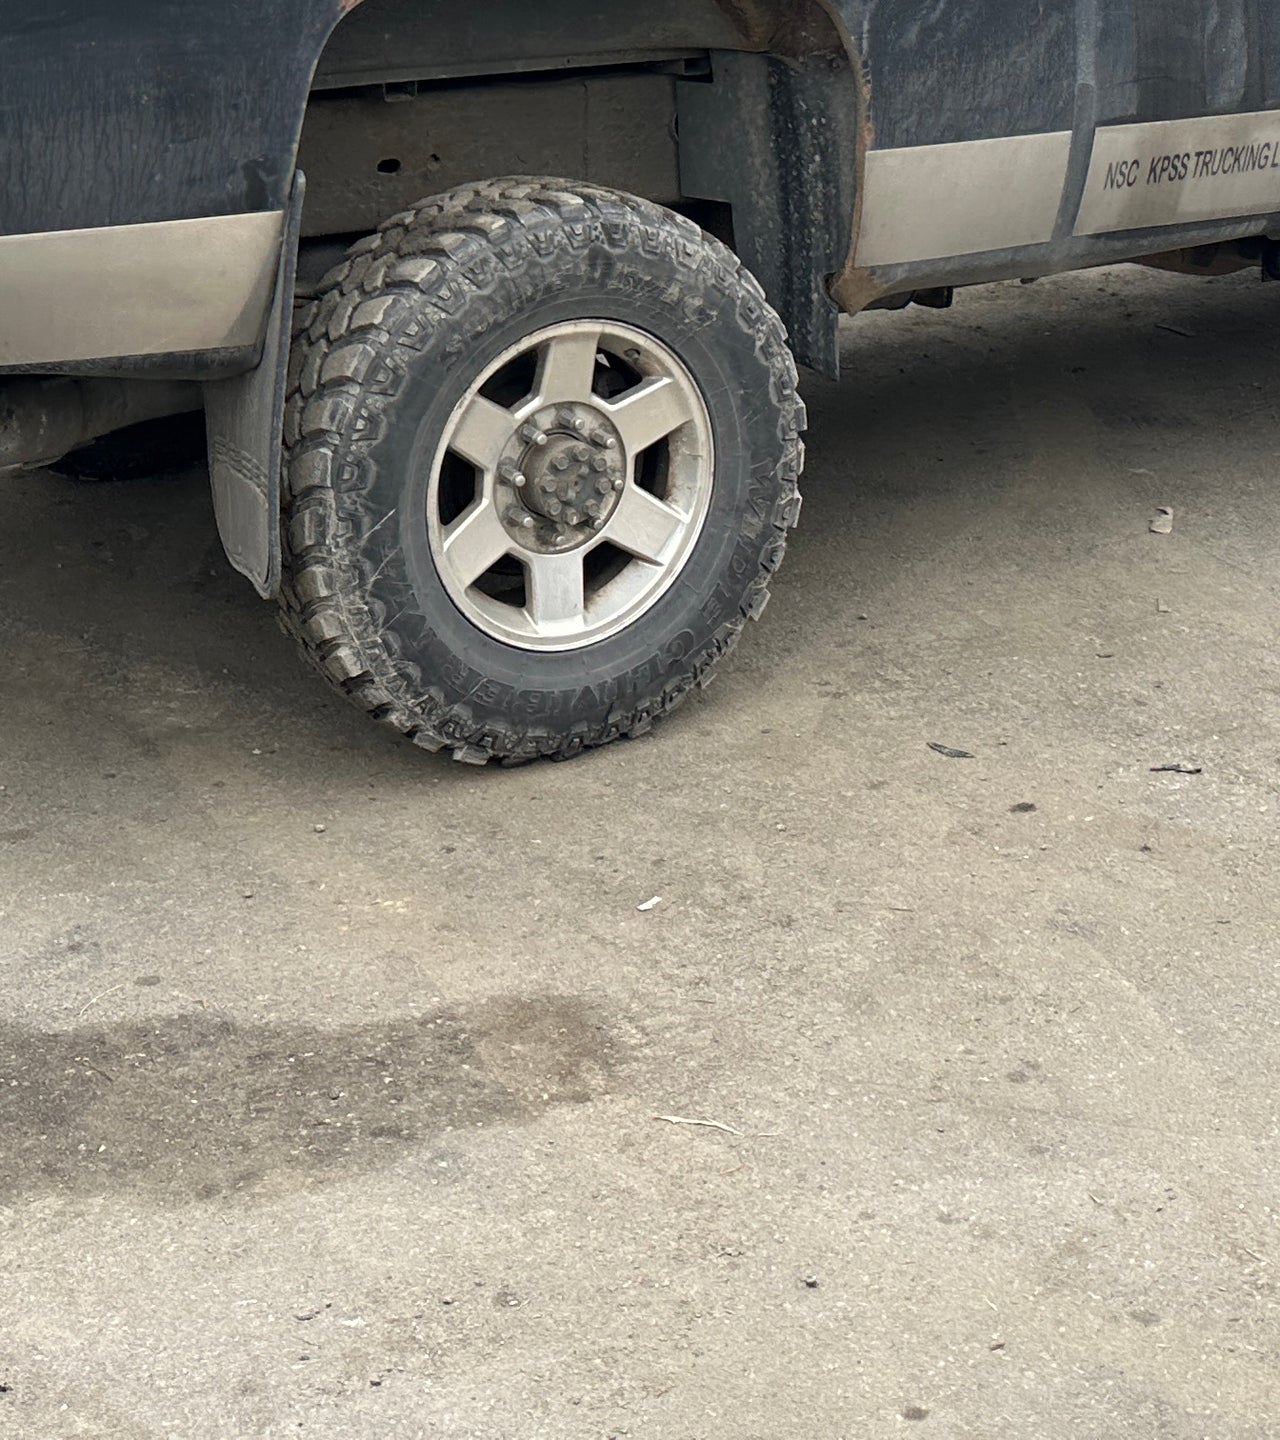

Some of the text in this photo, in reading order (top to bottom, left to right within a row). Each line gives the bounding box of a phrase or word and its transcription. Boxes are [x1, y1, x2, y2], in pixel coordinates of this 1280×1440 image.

[1104, 160, 1140, 190] NSC
[1147, 153, 1190, 185] KPSS
[1192, 141, 1270, 179] TRUCKING
